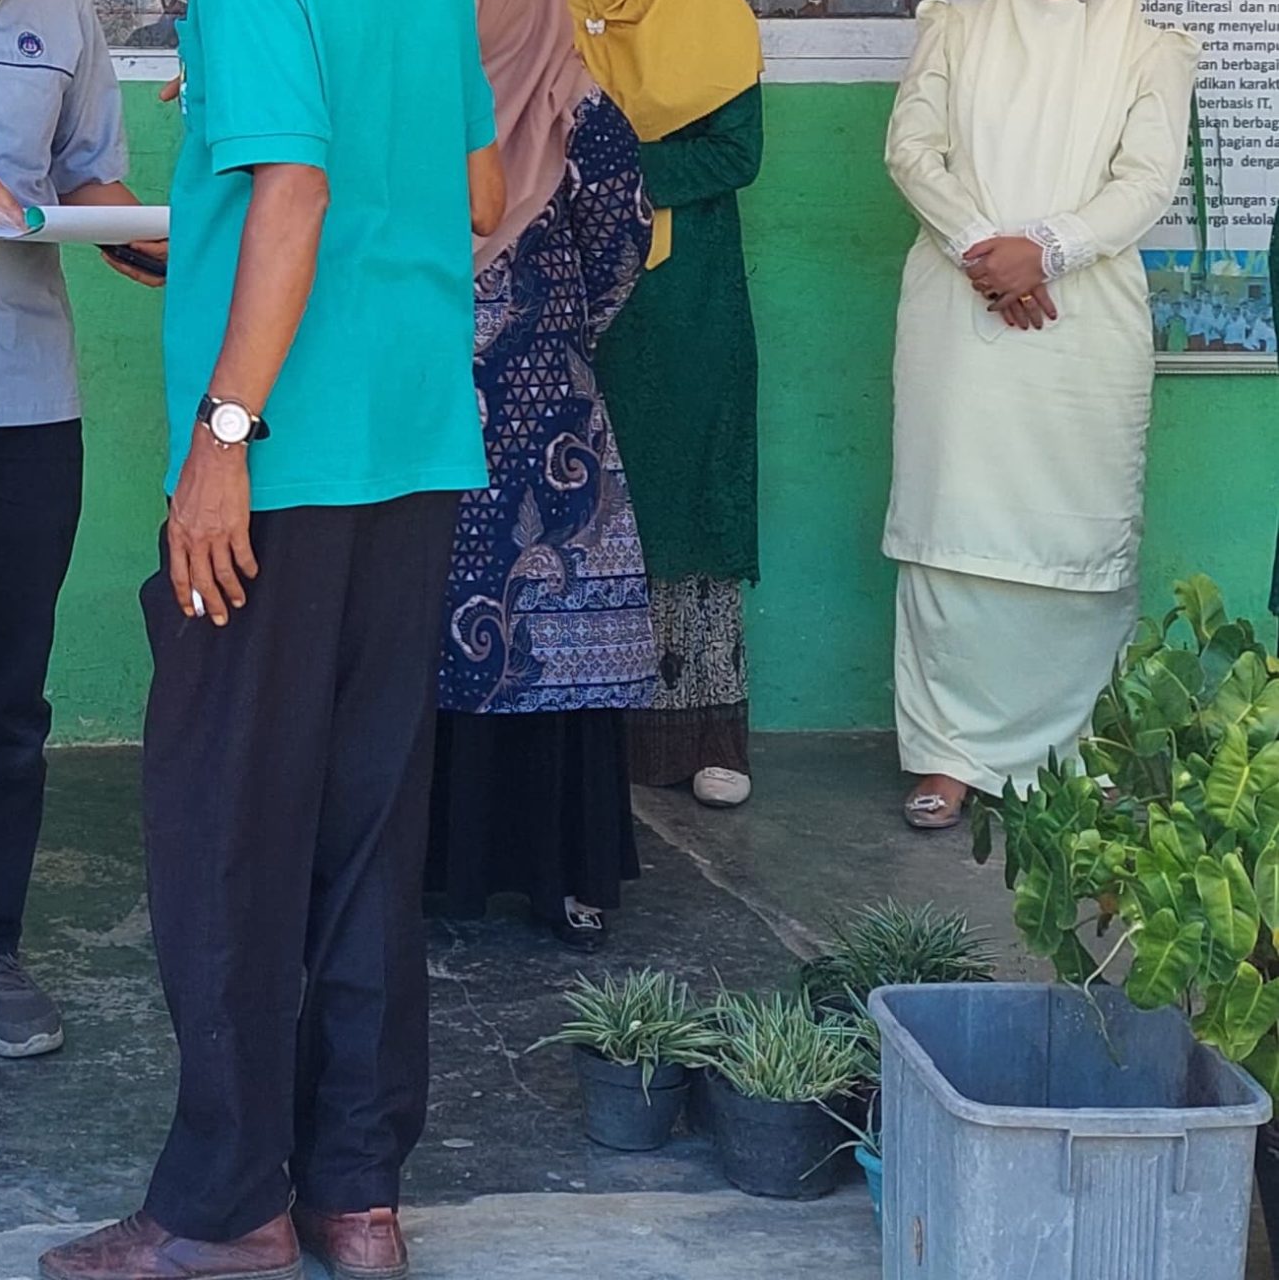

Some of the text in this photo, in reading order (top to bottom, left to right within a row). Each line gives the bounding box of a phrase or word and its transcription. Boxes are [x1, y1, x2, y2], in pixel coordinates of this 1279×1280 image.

[1187, 0, 1232, 12] literasi
[1239, 1, 1264, 12] dan
[1199, 97, 1253, 109] berbasis
[1186, 217, 1228, 227] wrga
